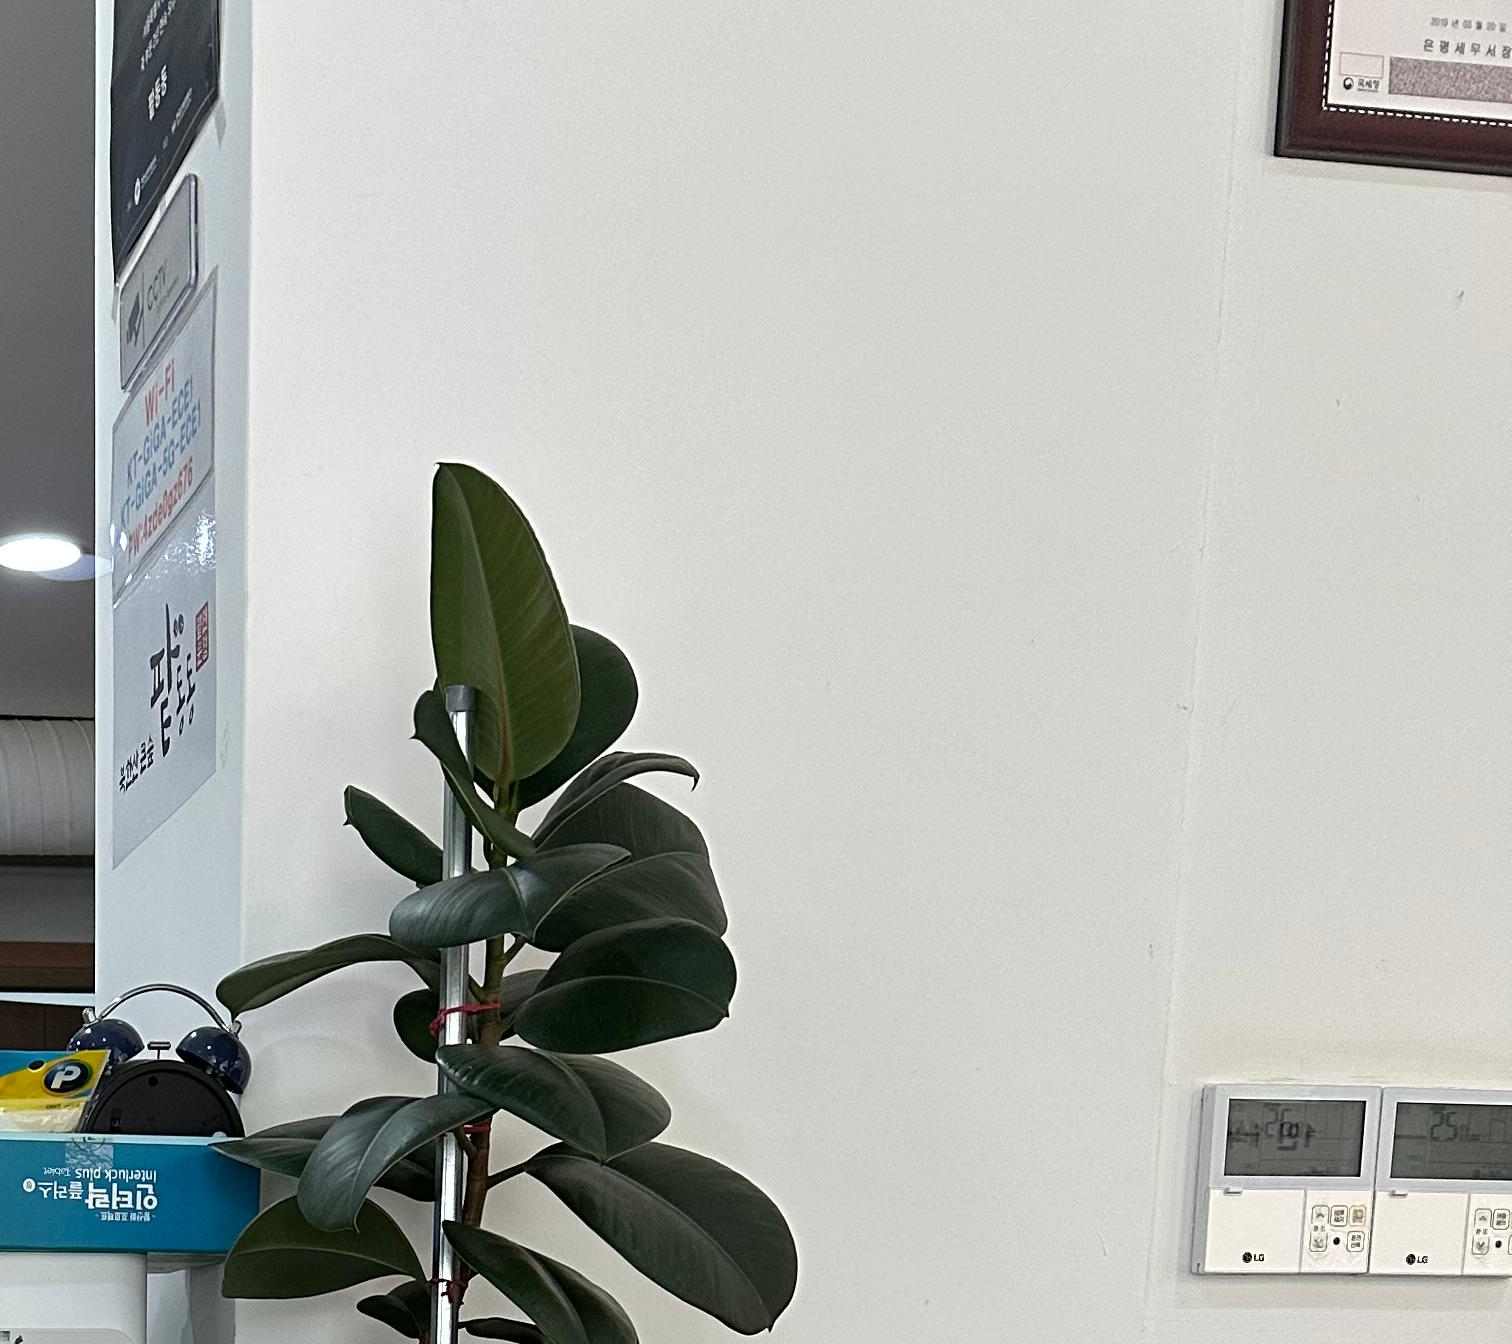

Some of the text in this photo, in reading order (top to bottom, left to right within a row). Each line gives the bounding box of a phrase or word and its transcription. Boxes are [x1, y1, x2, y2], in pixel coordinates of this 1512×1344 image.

[145, 359, 176, 426] Wi-Fi
[75, 1166, 102, 1181] plus
[104, 1168, 157, 1183] Interluck
[37, 1181, 84, 1199] 플러스
[85, 1182, 158, 1210] 인터락
[1253, 1253, 1265, 1262] LG
[1416, 1255, 1429, 1264] LG
